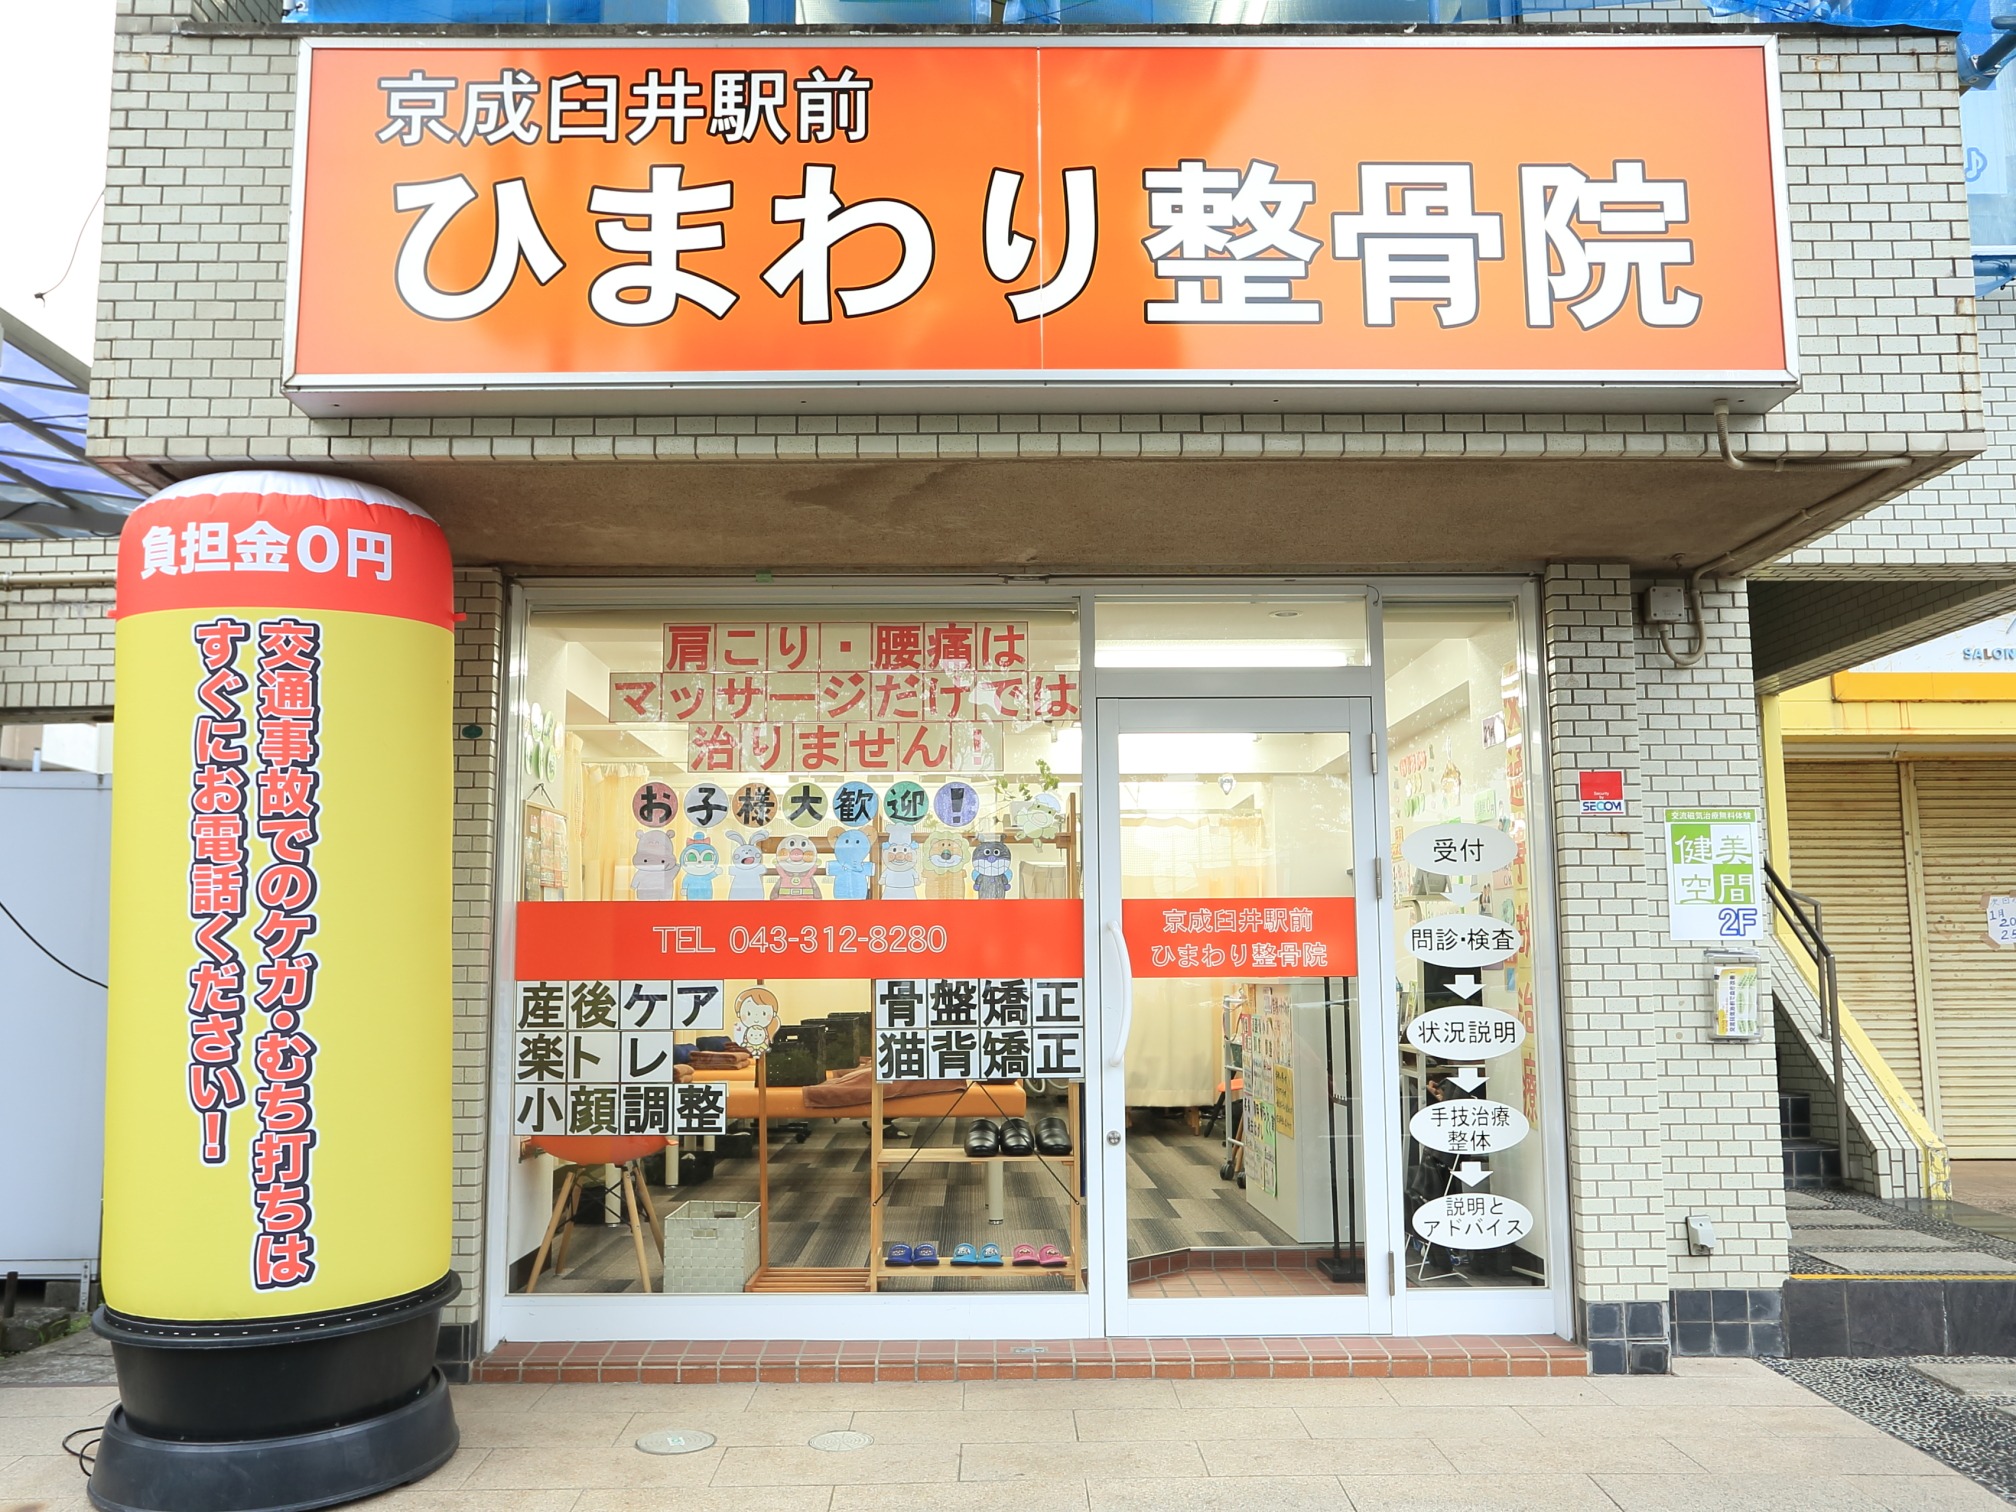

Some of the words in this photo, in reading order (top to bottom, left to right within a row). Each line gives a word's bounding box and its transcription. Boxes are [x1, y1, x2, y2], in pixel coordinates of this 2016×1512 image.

[376, 66, 872, 145] 京成臼井駅前
[393, 158, 1704, 330] ひまわり整骨院
[140, 520, 393, 581] 負担金0円
[666, 624, 1026, 671] 肩こり・腰痛は
[614, 672, 1078, 718] マッサージだけでは
[690, 723, 984, 771] 治りません！
[639, 786, 966, 826] お子様大歓迎！
[1582, 801, 1622, 811] SECOM
[1432, 837, 1485, 863] 受付
[1674, 834, 1751, 865] 健美
[189, 618, 250, 1164] すぐにお電話ください！
[1680, 873, 1754, 904] 空間
[1162, 907, 1314, 933] 京成臼井駅前
[1718, 908, 1758, 937] 2F
[254, 618, 320, 1290] 交通事故でのケガ・むち打ちは
[653, 926, 715, 953] TEL
[729, 925, 948, 954] 043-312-8280
[1151, 942, 1328, 968] ひまわり整骨院
[1411, 927, 1515, 951] 問診・検査
[517, 980, 722, 1030] 産後ケア
[878, 978, 1082, 1028] 骨盤矯正
[1417, 1020, 1516, 1044] 状況説明
[517, 1031, 668, 1081] 楽トレ
[877, 1030, 1083, 1079] 猫背矯正
[517, 1084, 724, 1134] 小顔調整
[1430, 1105, 1511, 1127] 手技治療
[1447, 1130, 1492, 1152] 整体
[1445, 1197, 1504, 1217] 説明と
[1423, 1218, 1524, 1238] アドバイス
